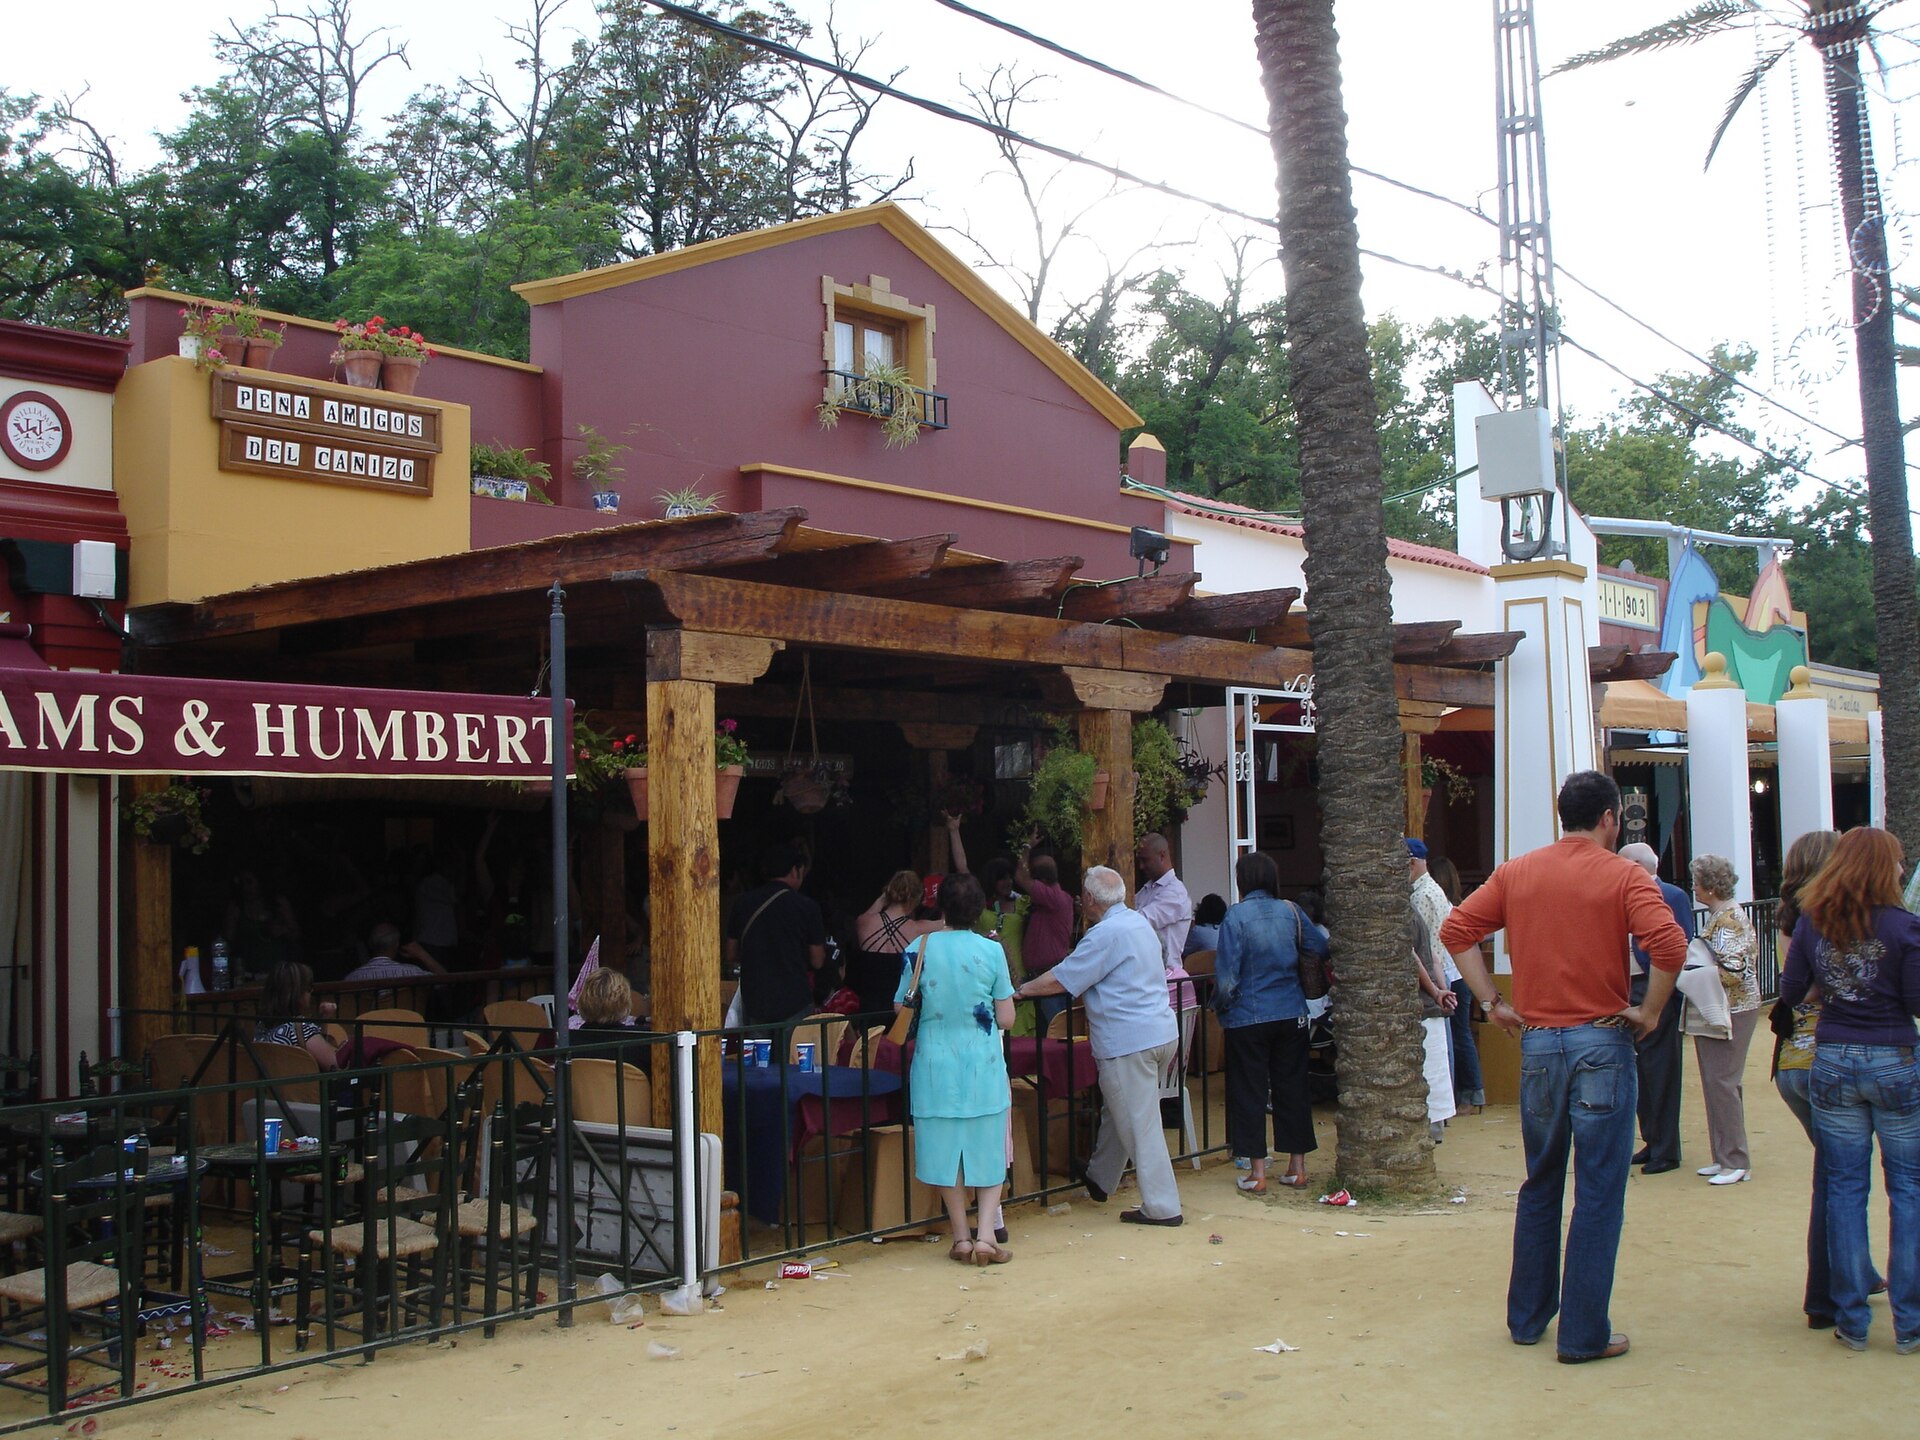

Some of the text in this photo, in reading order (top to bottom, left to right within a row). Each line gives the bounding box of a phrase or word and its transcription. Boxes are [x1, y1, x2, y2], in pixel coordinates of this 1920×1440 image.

[13, 407, 54, 427] WILLIAMS
[326, 403, 421, 436] AMIGOS
[13, 433, 55, 455] HUMBERT
[249, 439, 298, 462] DEL
[173, 698, 226, 759] &
[252, 702, 553, 766] HUMBERT
